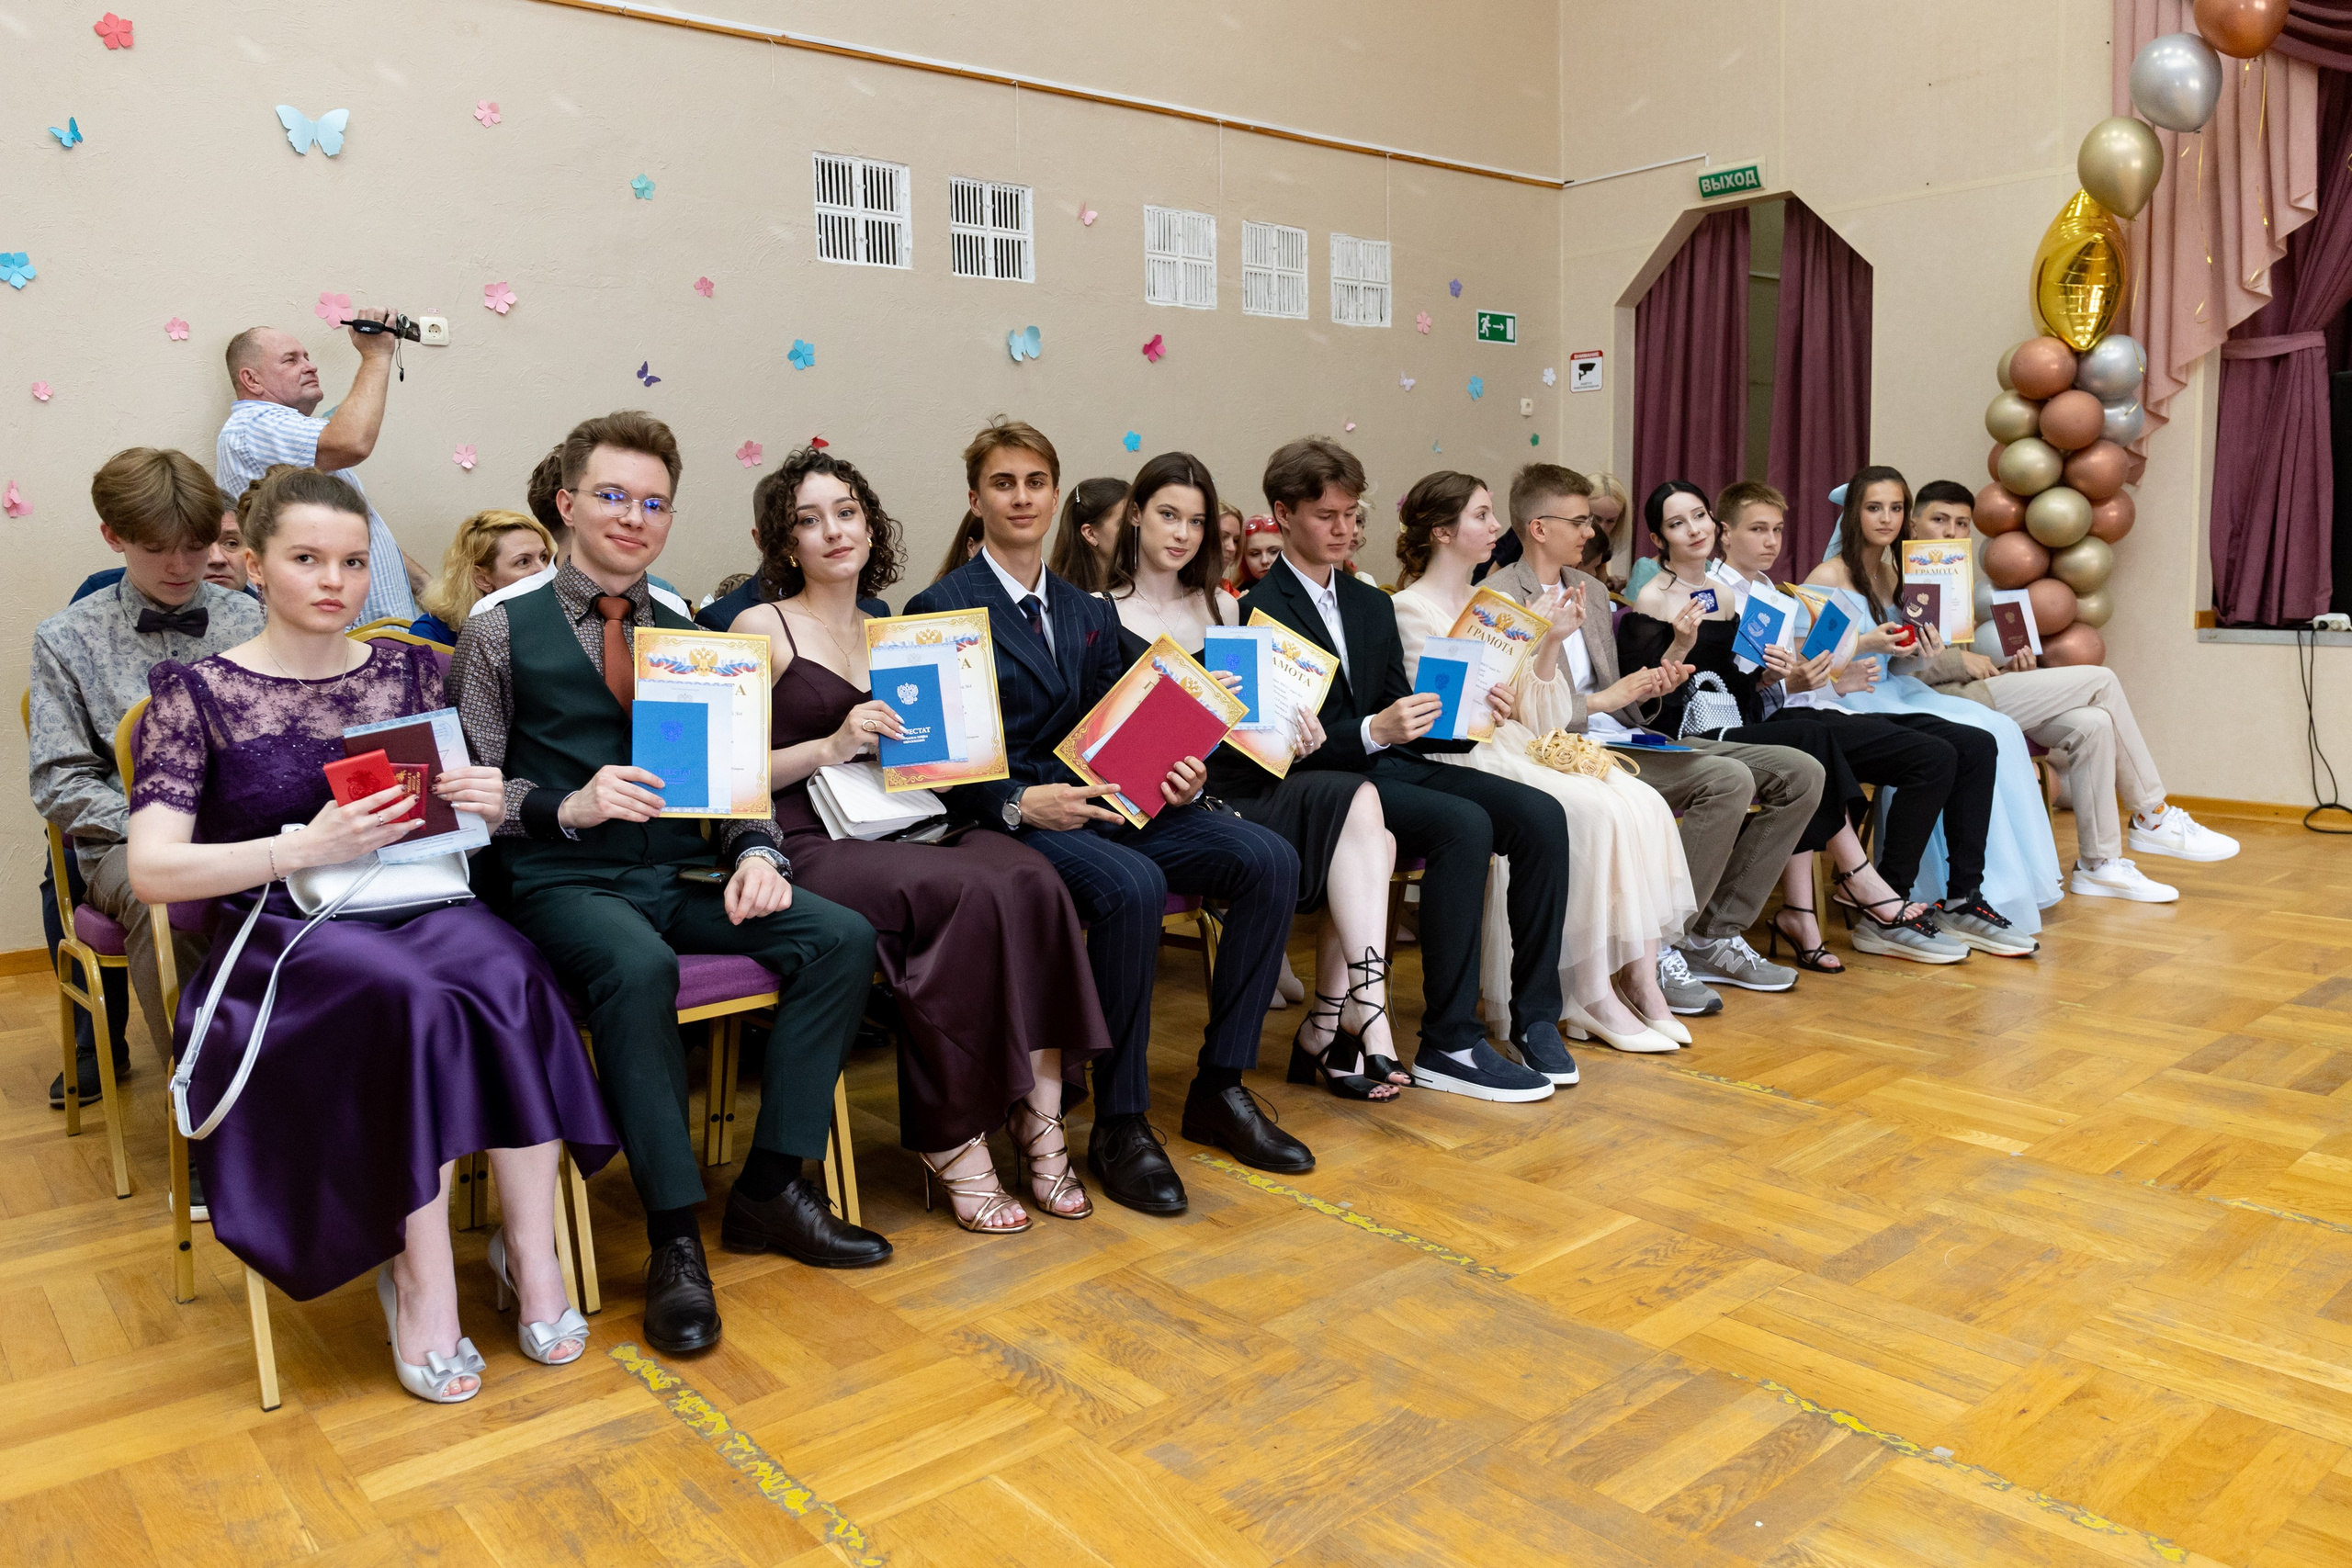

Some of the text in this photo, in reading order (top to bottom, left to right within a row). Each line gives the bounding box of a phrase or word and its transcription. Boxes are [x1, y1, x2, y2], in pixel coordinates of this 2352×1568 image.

[1701, 170, 1758, 193] ВЫХОД
[1466, 625, 1515, 656] ГРАМОТА
[1272, 656, 1311, 687] АМОТА
[907, 726, 932, 735] ЕСТАТ
